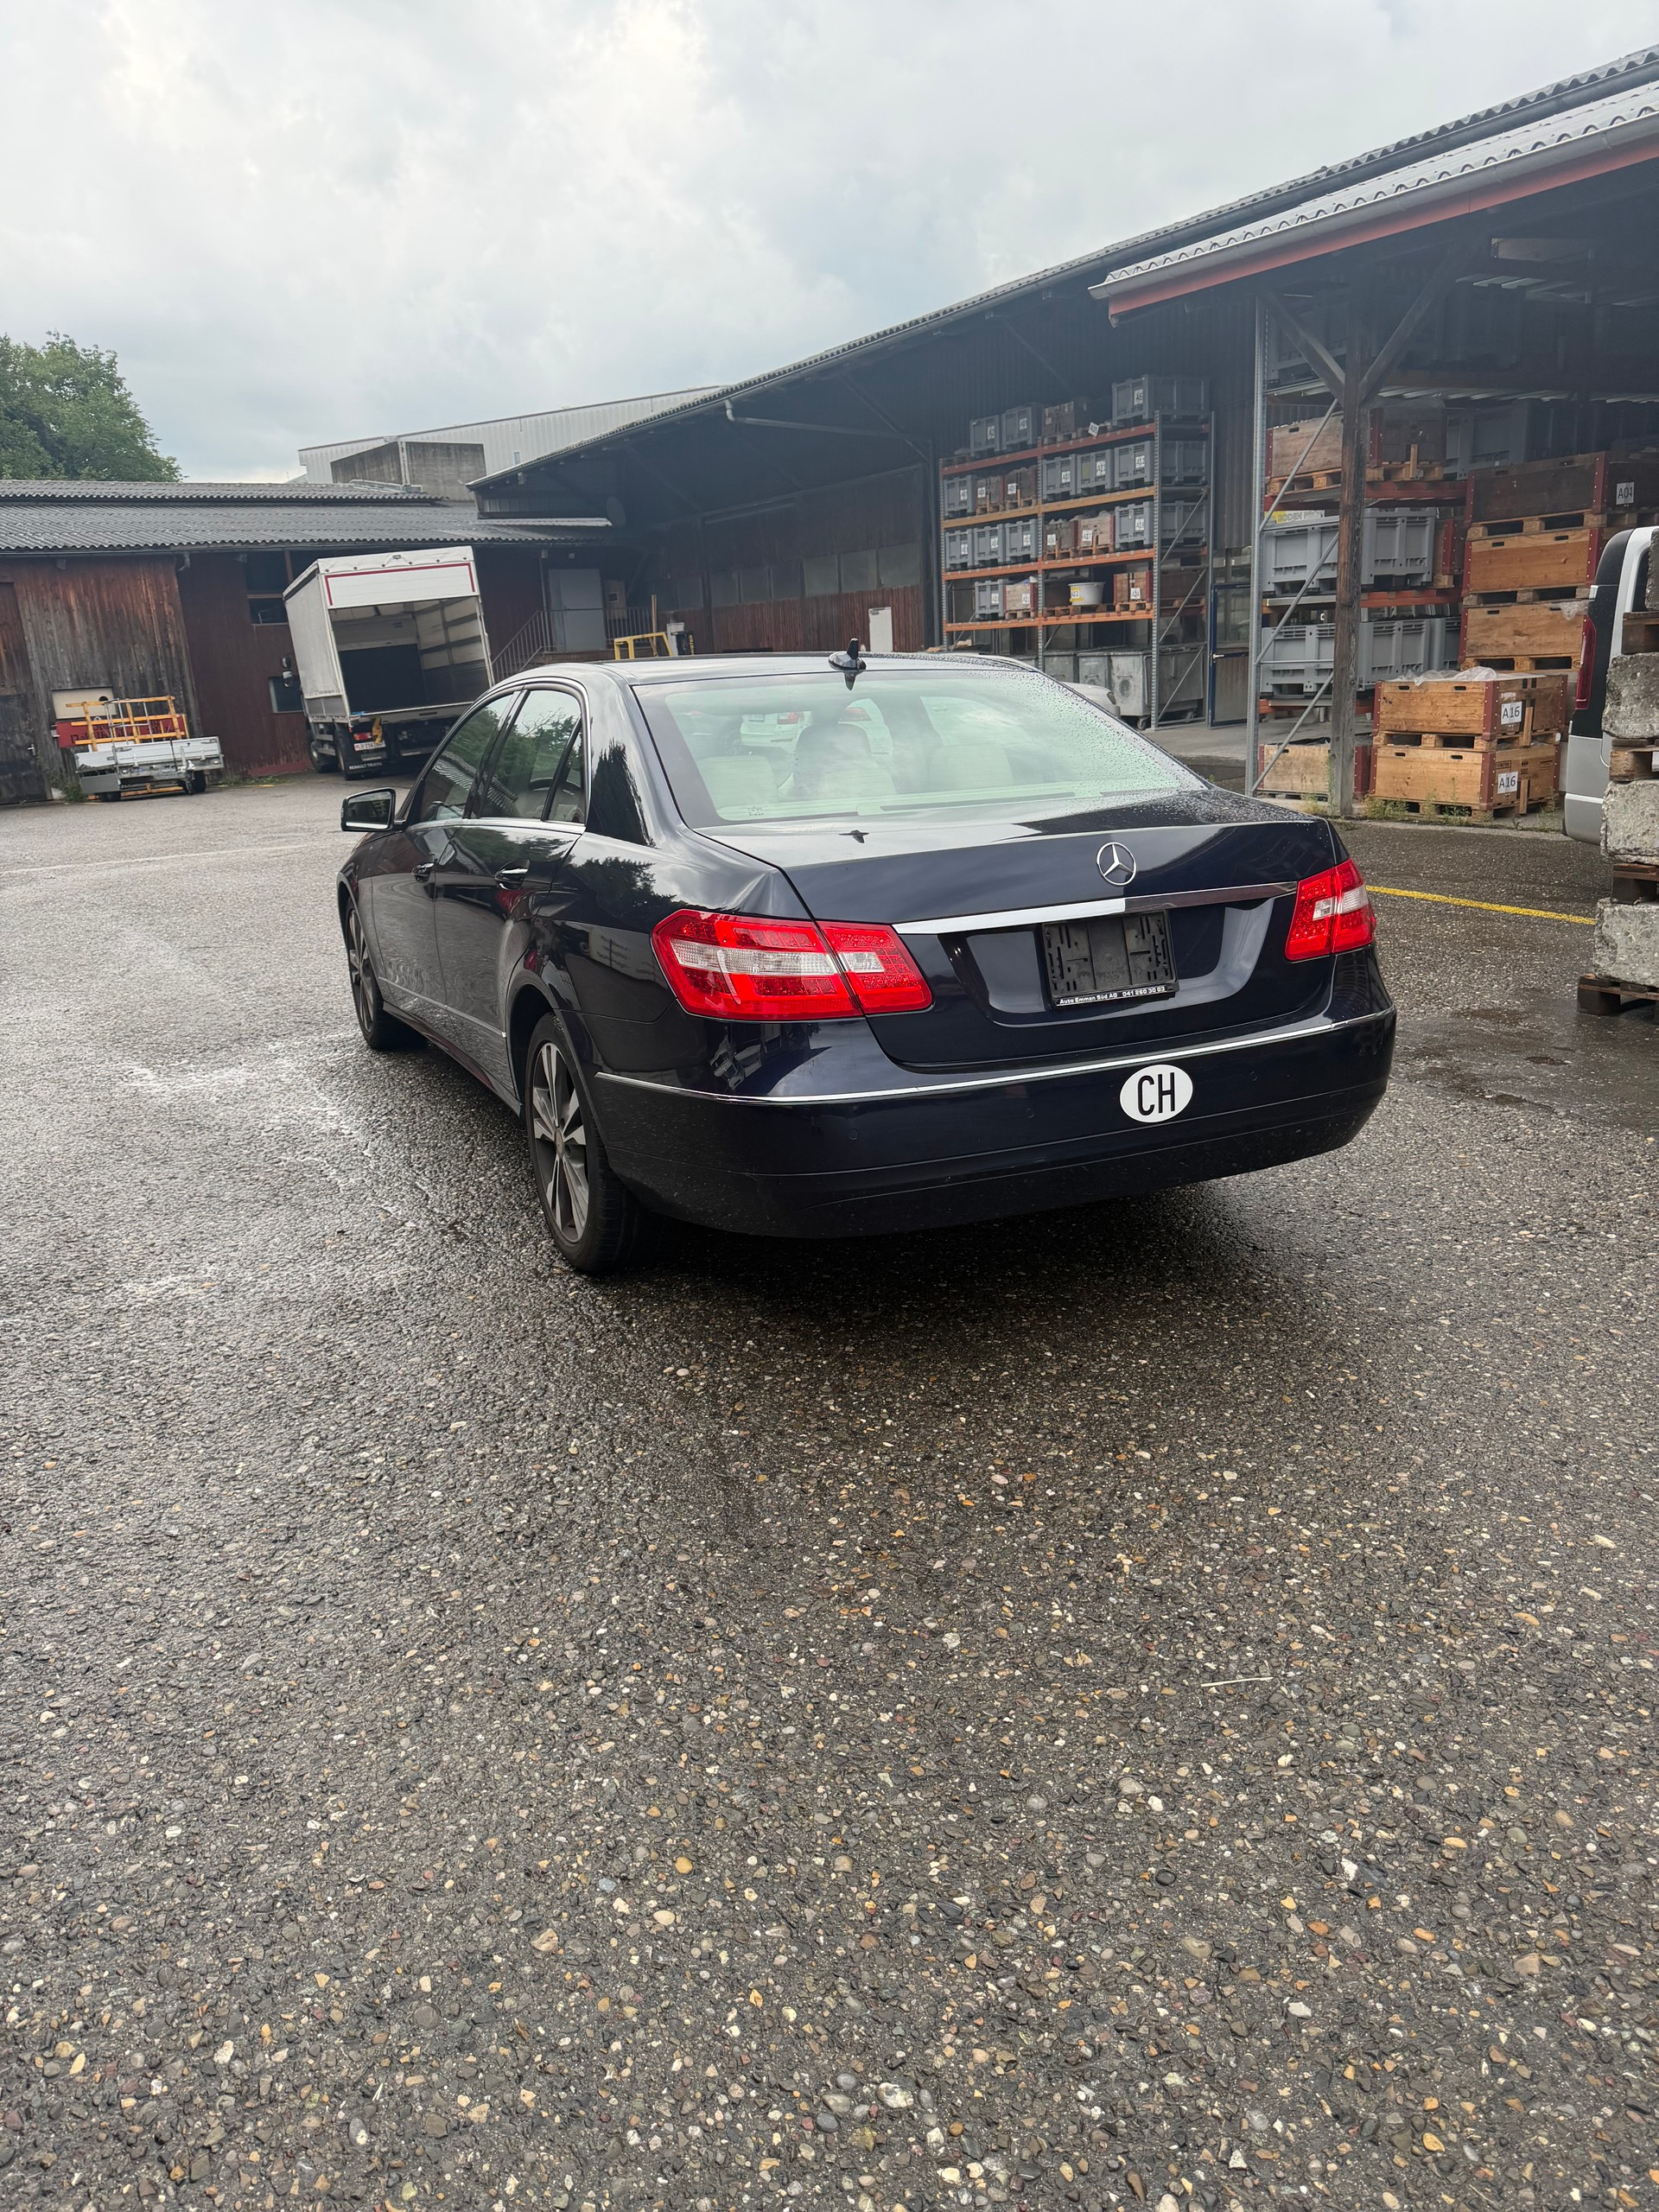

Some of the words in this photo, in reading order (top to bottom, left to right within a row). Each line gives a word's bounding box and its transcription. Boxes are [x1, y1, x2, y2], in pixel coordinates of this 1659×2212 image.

[1618, 486, 1633, 499] A04
[1502, 706, 1521, 719] A16
[1498, 776, 1516, 789] A16
[1137, 1072, 1175, 1116] CH
